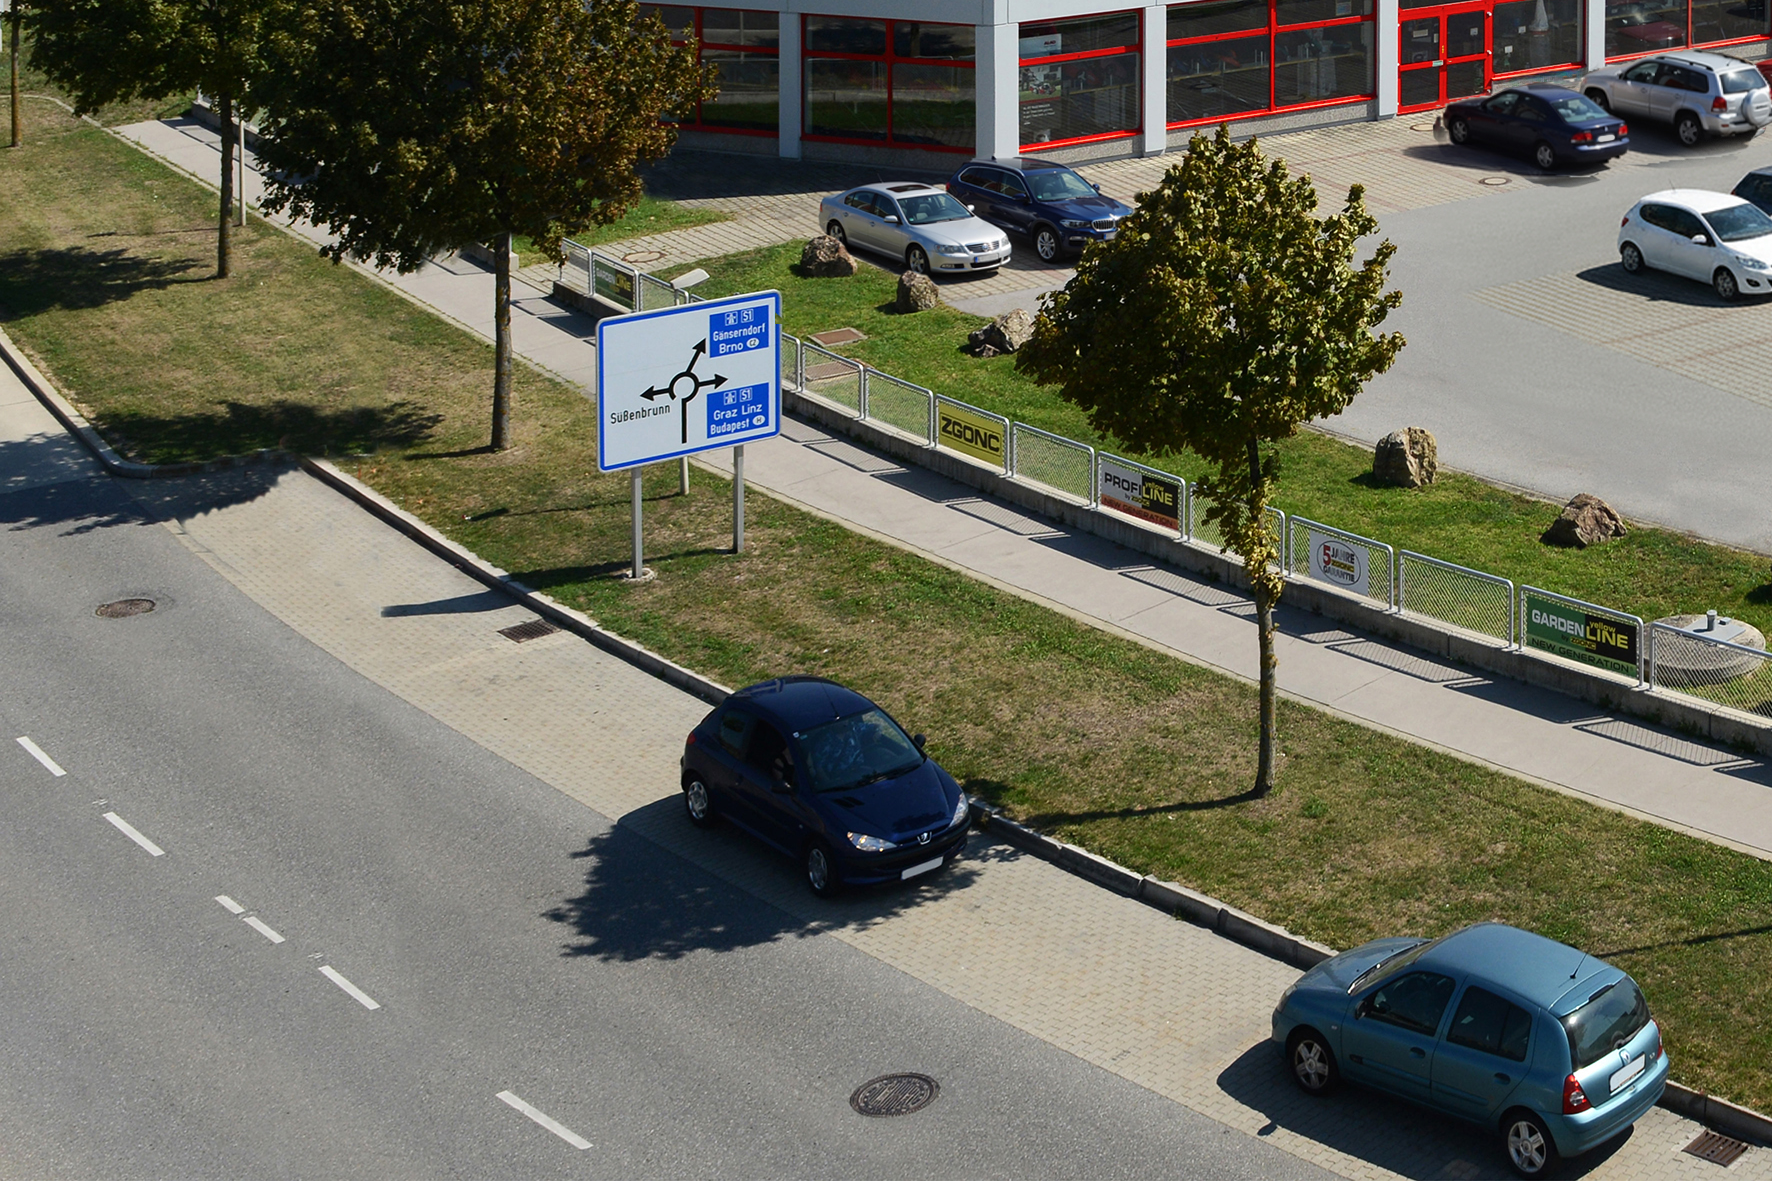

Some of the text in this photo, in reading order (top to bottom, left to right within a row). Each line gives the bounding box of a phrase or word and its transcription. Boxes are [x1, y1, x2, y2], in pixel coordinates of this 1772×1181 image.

[743, 310, 752, 321] S1
[713, 322, 766, 341] Gänserndorf
[719, 339, 757, 354] Brno CZ
[742, 389, 751, 400] S1
[610, 405, 671, 424] Süßenbrunn
[713, 404, 763, 421] Graz Linz
[710, 418, 750, 435] Budapest
[941, 416, 1000, 453] ZGONC
[1122, 503, 1173, 526] GENERATION
[1323, 544, 1355, 566] 5 JAHRE
[1323, 565, 1355, 582] GARANTIE
[1531, 609, 1629, 650] GARDEN LINE
[1590, 621, 1616, 633] yellow
[1531, 638, 1630, 673] NEW GENERATION
